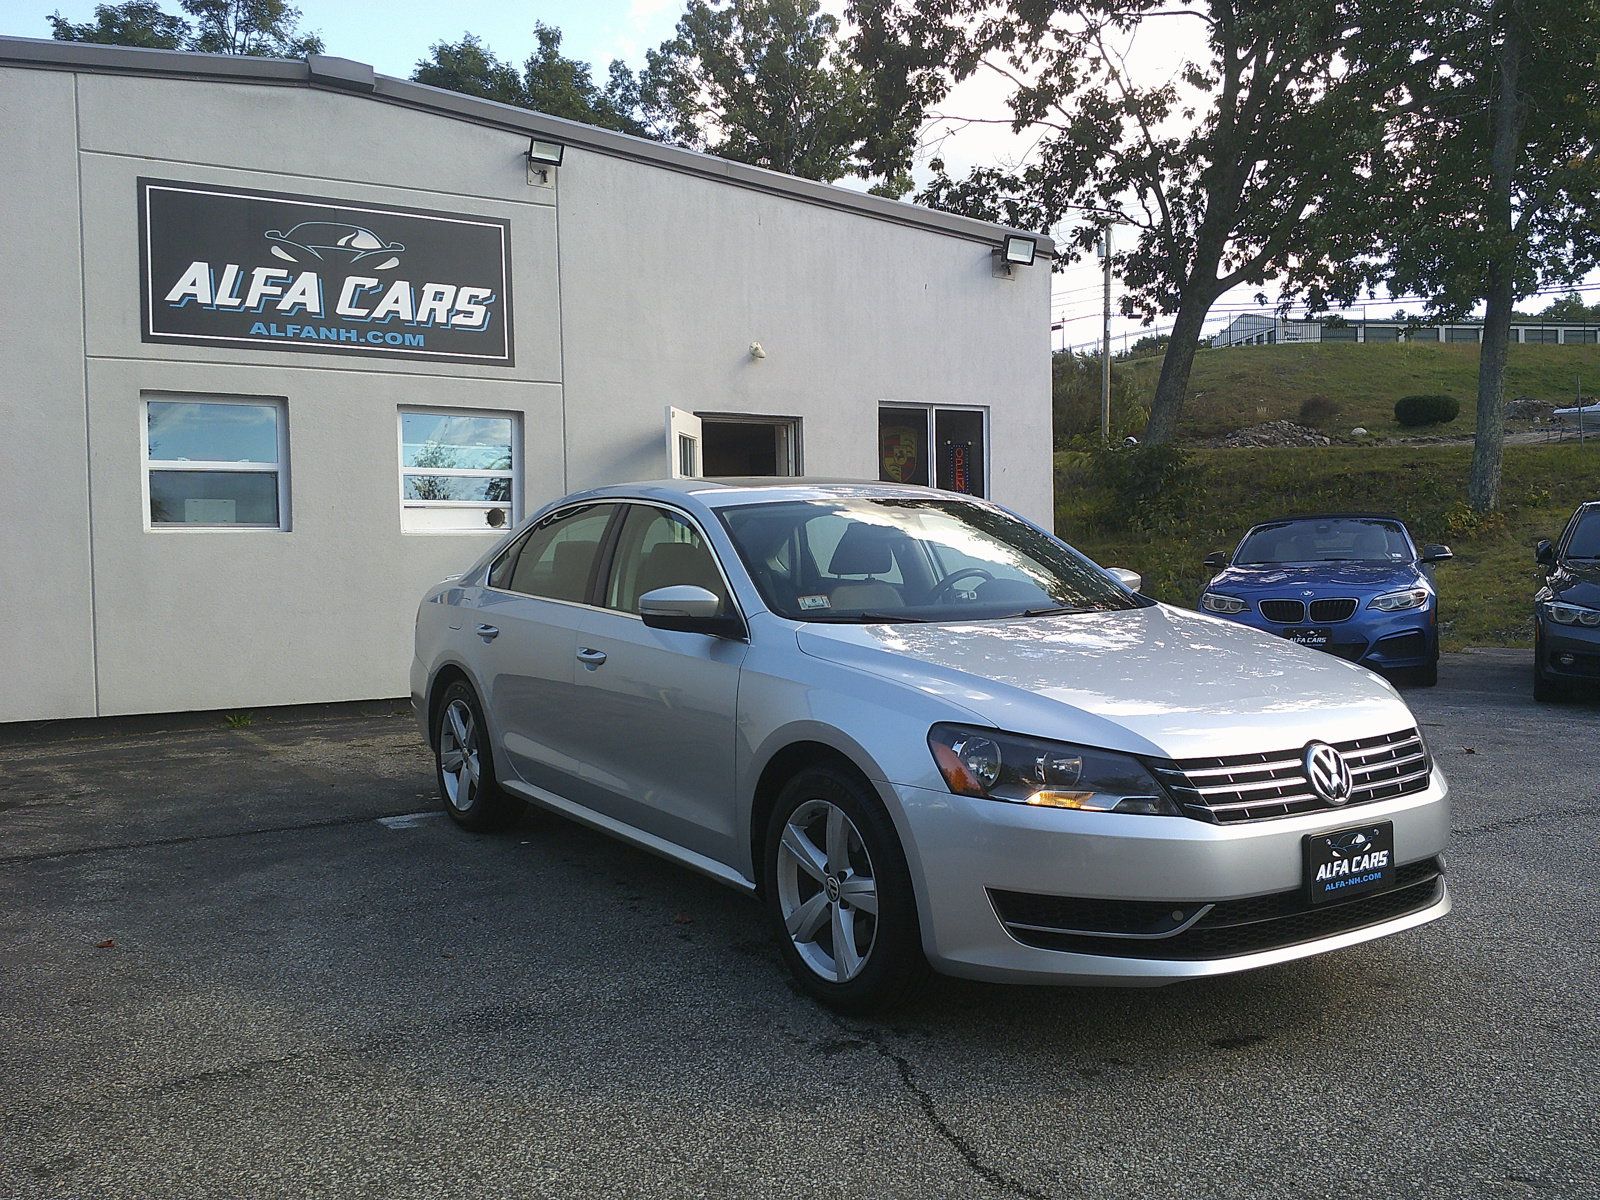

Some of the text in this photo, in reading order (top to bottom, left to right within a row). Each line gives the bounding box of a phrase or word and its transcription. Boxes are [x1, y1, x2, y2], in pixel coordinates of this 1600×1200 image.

[165, 261, 494, 329] ALFA CARS
[249, 321, 425, 347] ALFANH.COM
[955, 447, 965, 490] OPEN
[1316, 850, 1388, 881] ALFA CARS
[1325, 872, 1382, 892] ALFA-NH.COM
